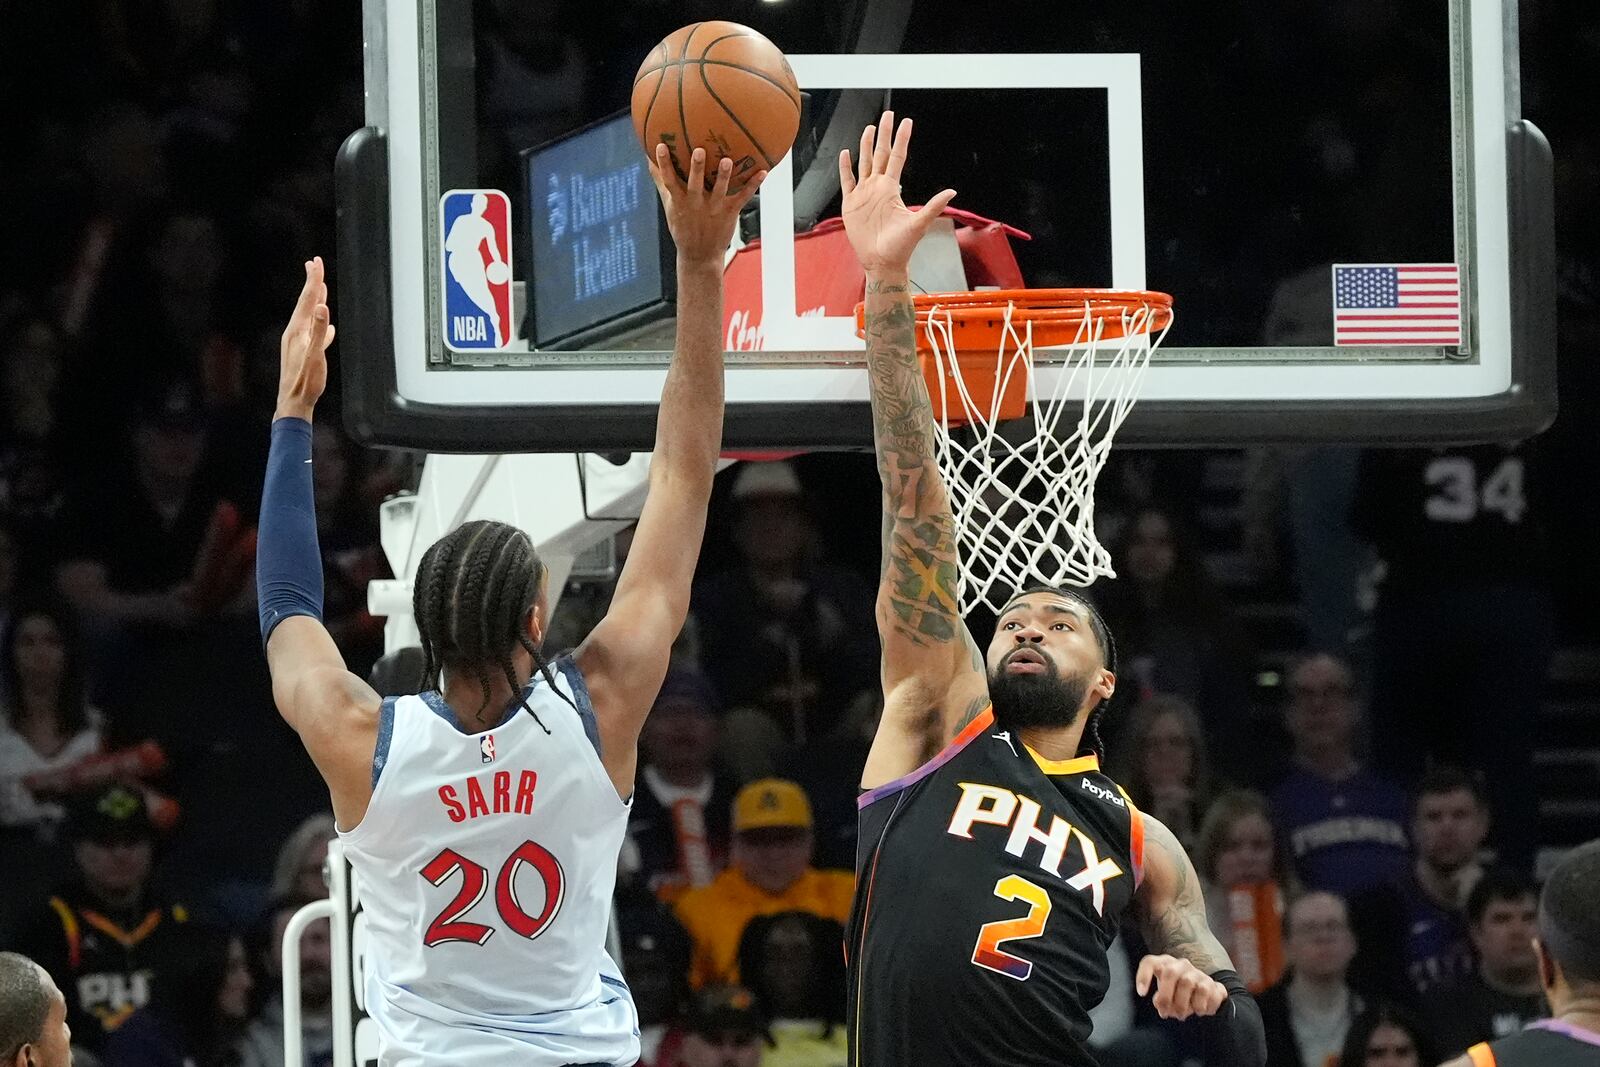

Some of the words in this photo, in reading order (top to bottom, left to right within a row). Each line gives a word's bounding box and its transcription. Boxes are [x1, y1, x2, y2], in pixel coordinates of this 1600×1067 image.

[570, 163, 641, 233] Banner
[573, 220, 638, 303] Health
[453, 316, 487, 341] NBA
[1424, 457, 1526, 522] 34
[438, 769, 537, 823] SARR
[1081, 777, 1125, 807] PayPal
[947, 782, 1124, 918] PHX
[419, 839, 566, 948] 20
[971, 873, 1052, 982] 2
